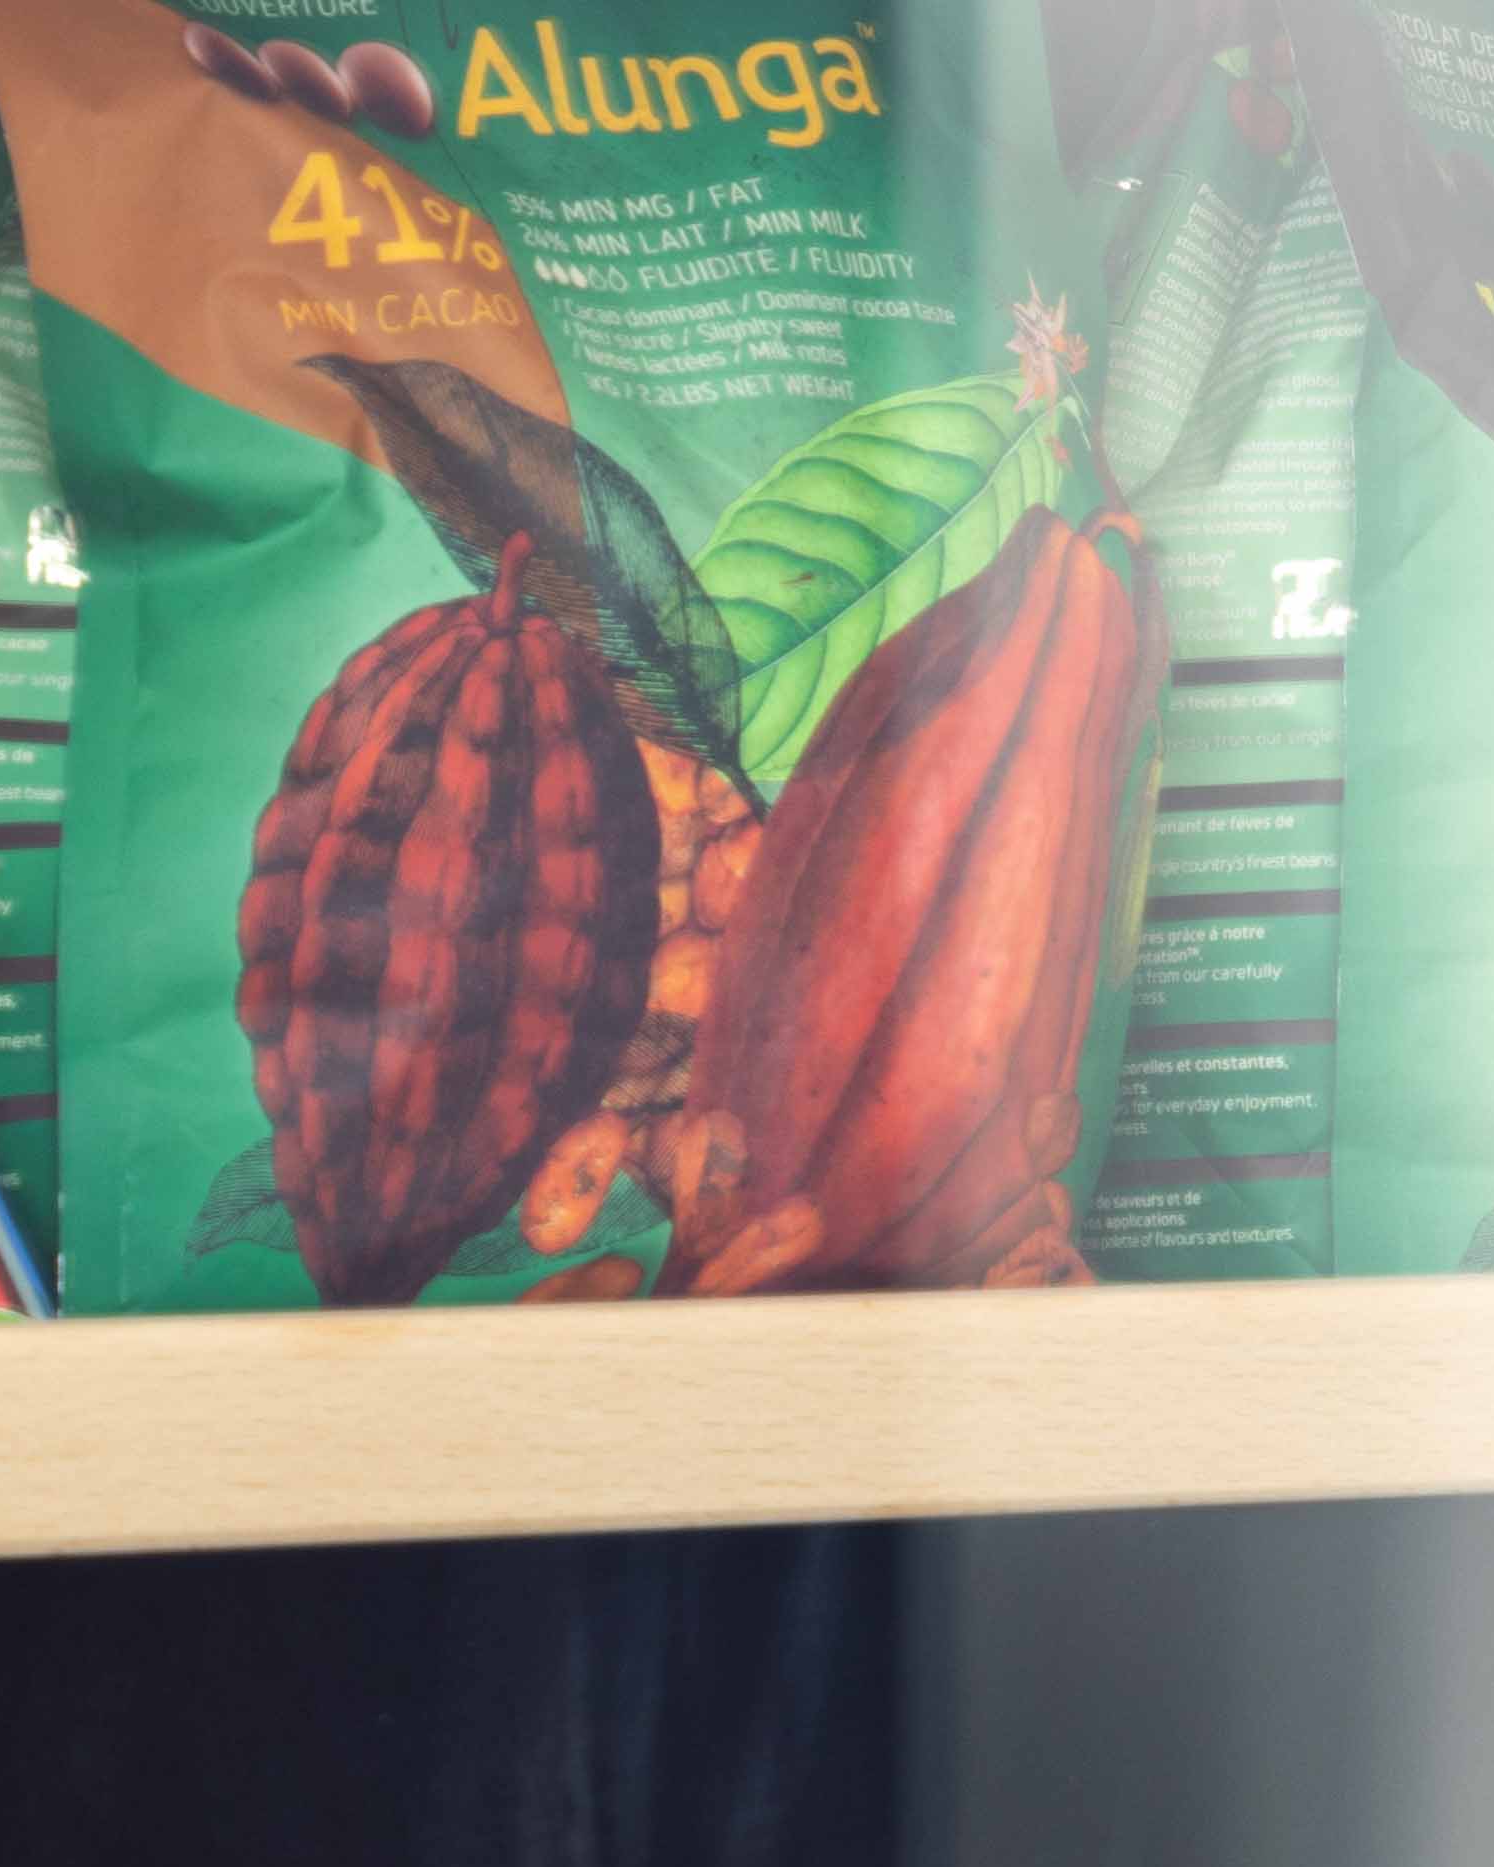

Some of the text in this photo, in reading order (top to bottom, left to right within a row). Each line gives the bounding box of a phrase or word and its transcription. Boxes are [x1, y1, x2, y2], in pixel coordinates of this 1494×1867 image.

[268, 150, 503, 271] 41%
[559, 198, 618, 223] MIN
[623, 193, 675, 222] MG
[707, 176, 765, 209] FAT
[572, 231, 632, 256] MIN
[636, 222, 706, 256] LAIT
[745, 209, 804, 237] MIN
[809, 208, 867, 240] MILK
[808, 247, 915, 280] FLUIDITY
[277, 287, 520, 336] MIN CACAO
[624, 299, 733, 328] dominant
[756, 289, 849, 316] Dominant
[852, 300, 910, 319] cocoa
[723, 373, 774, 399] NET
[1274, 814, 1295, 829] de
[1288, 851, 1337, 869] beans
[1221, 924, 1266, 942] notre
[1146, 960, 1283, 985] from our carefully
[1176, 1053, 1291, 1075] et constantes,
[1155, 1097, 1220, 1117] everyday
[1224, 1093, 1319, 1114] enjoyment.
[1183, 1189, 1202, 1207] de
